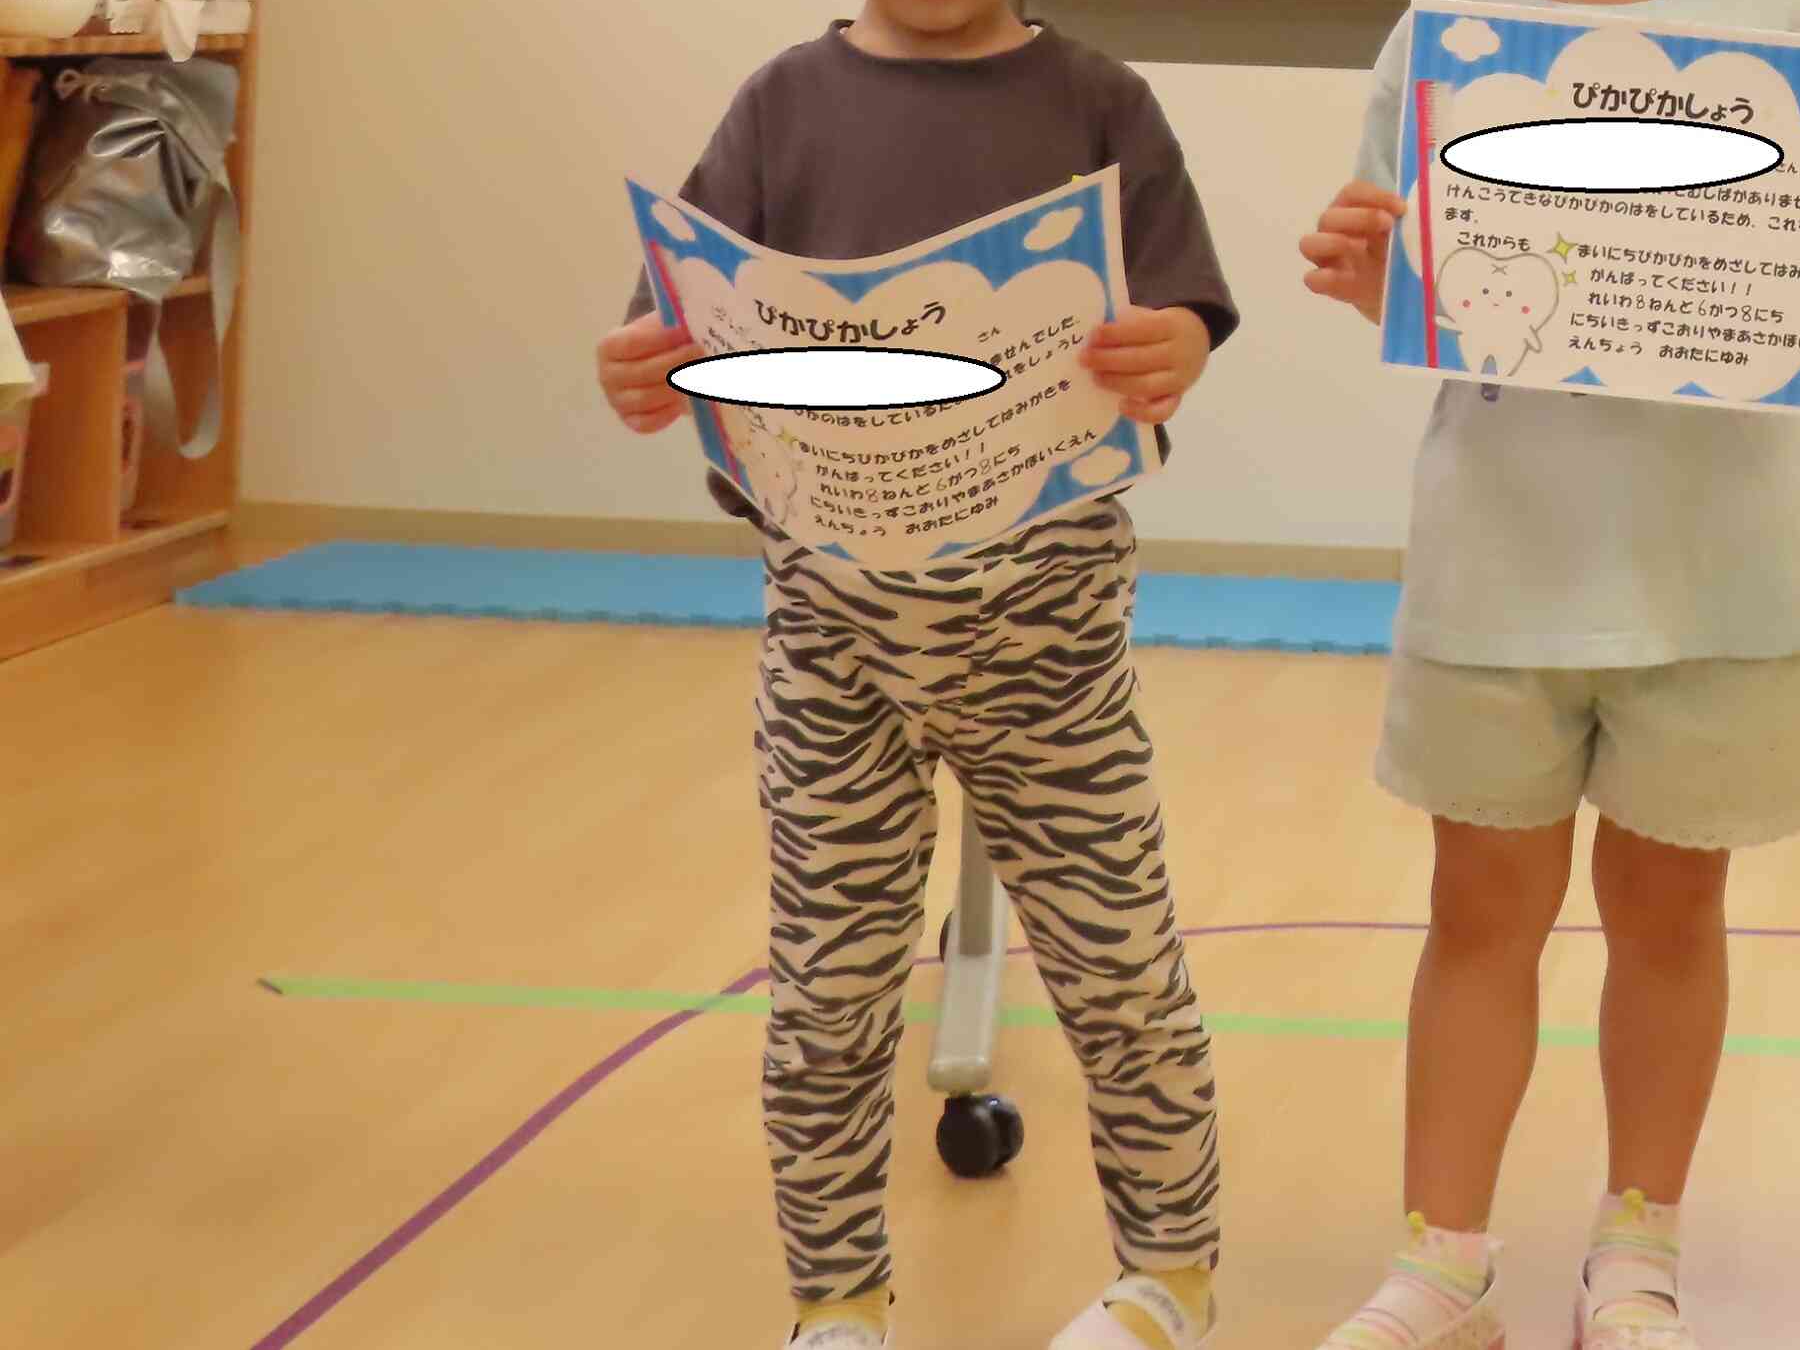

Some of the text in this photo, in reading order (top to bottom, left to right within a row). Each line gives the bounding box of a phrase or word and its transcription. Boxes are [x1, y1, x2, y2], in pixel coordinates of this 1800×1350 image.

[1572, 81, 1755, 125] ぴかぴかしょう
[1457, 231, 1531, 252] これからも
[753, 299, 947, 344] ぴかぴかしょう
